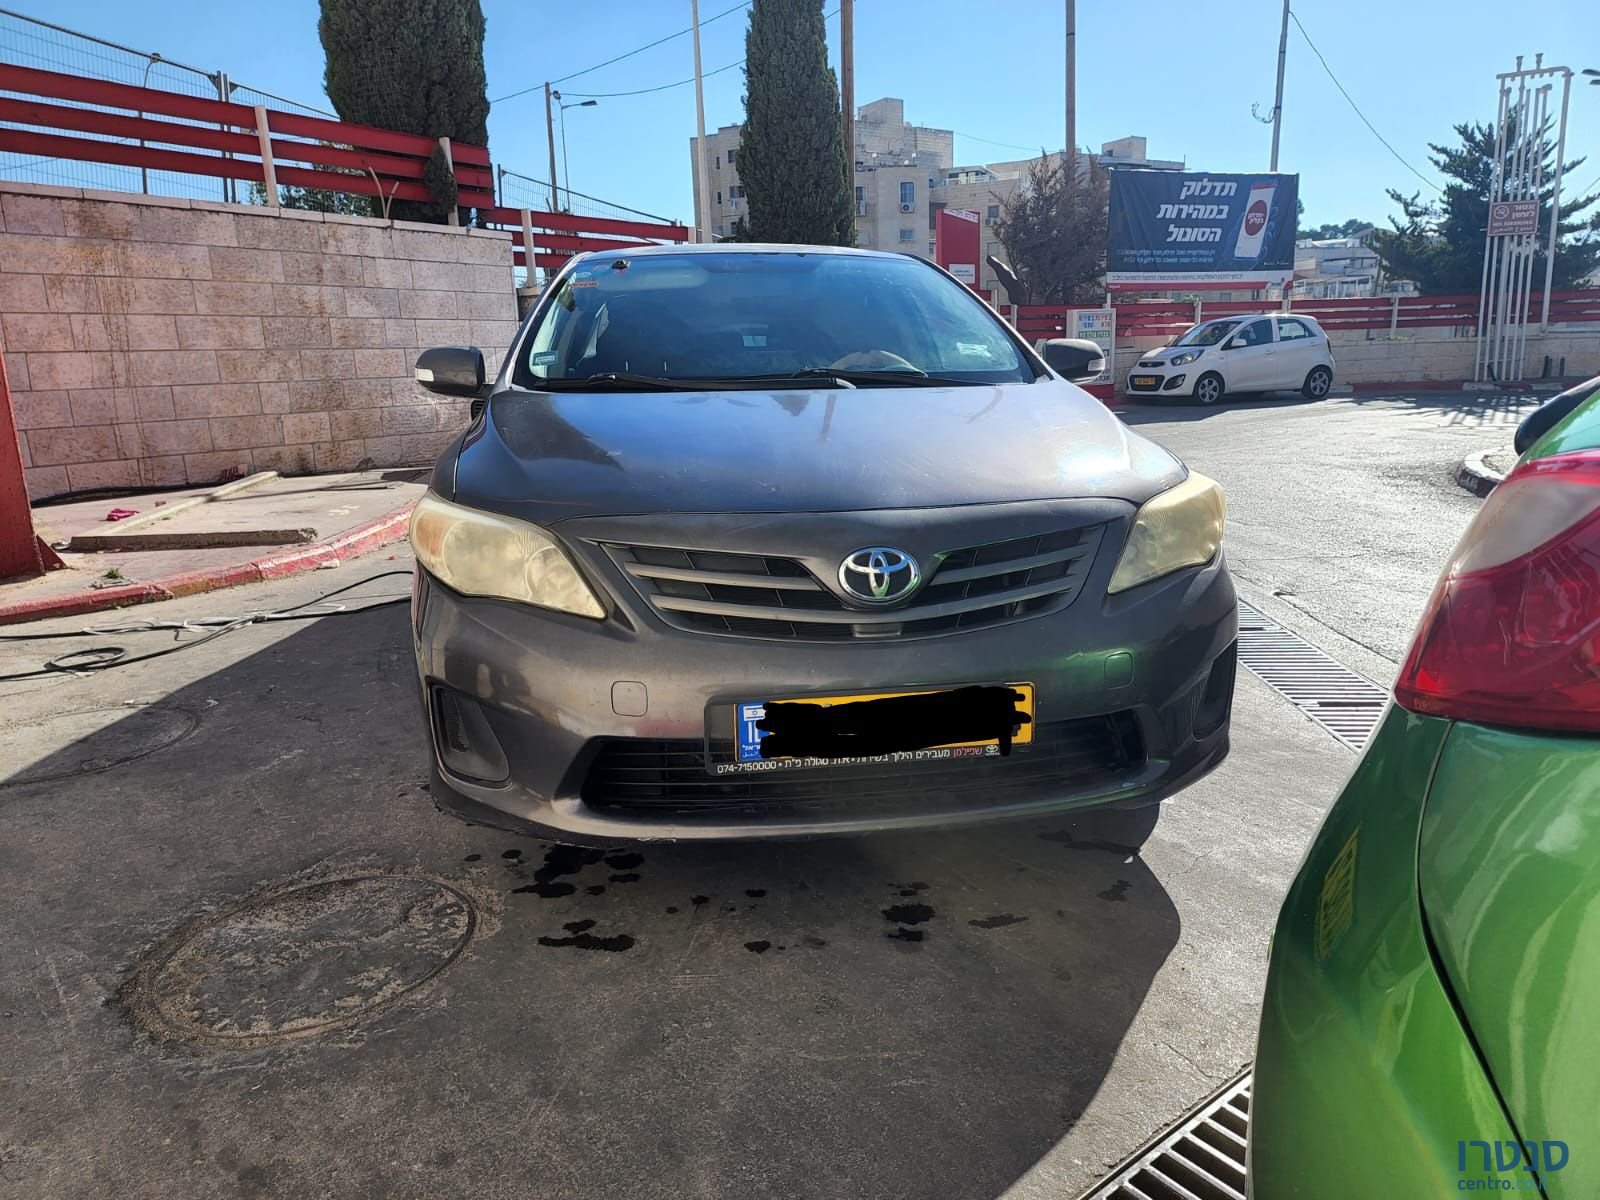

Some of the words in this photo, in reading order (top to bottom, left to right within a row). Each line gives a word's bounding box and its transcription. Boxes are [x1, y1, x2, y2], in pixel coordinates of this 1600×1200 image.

[1181, 178, 1237, 199] תדלוק
[1157, 204, 1228, 219] במהירות
[1512, 211, 1535, 219] לעשן
[1167, 225, 1222, 242] הסונול
[891, 750, 913, 763] הילוך
[915, 749, 951, 759] מעבירים
[953, 746, 983, 758] שפילמן
[716, 760, 777, 774] 074-7150000
[804, 757, 829, 767] סגולה
